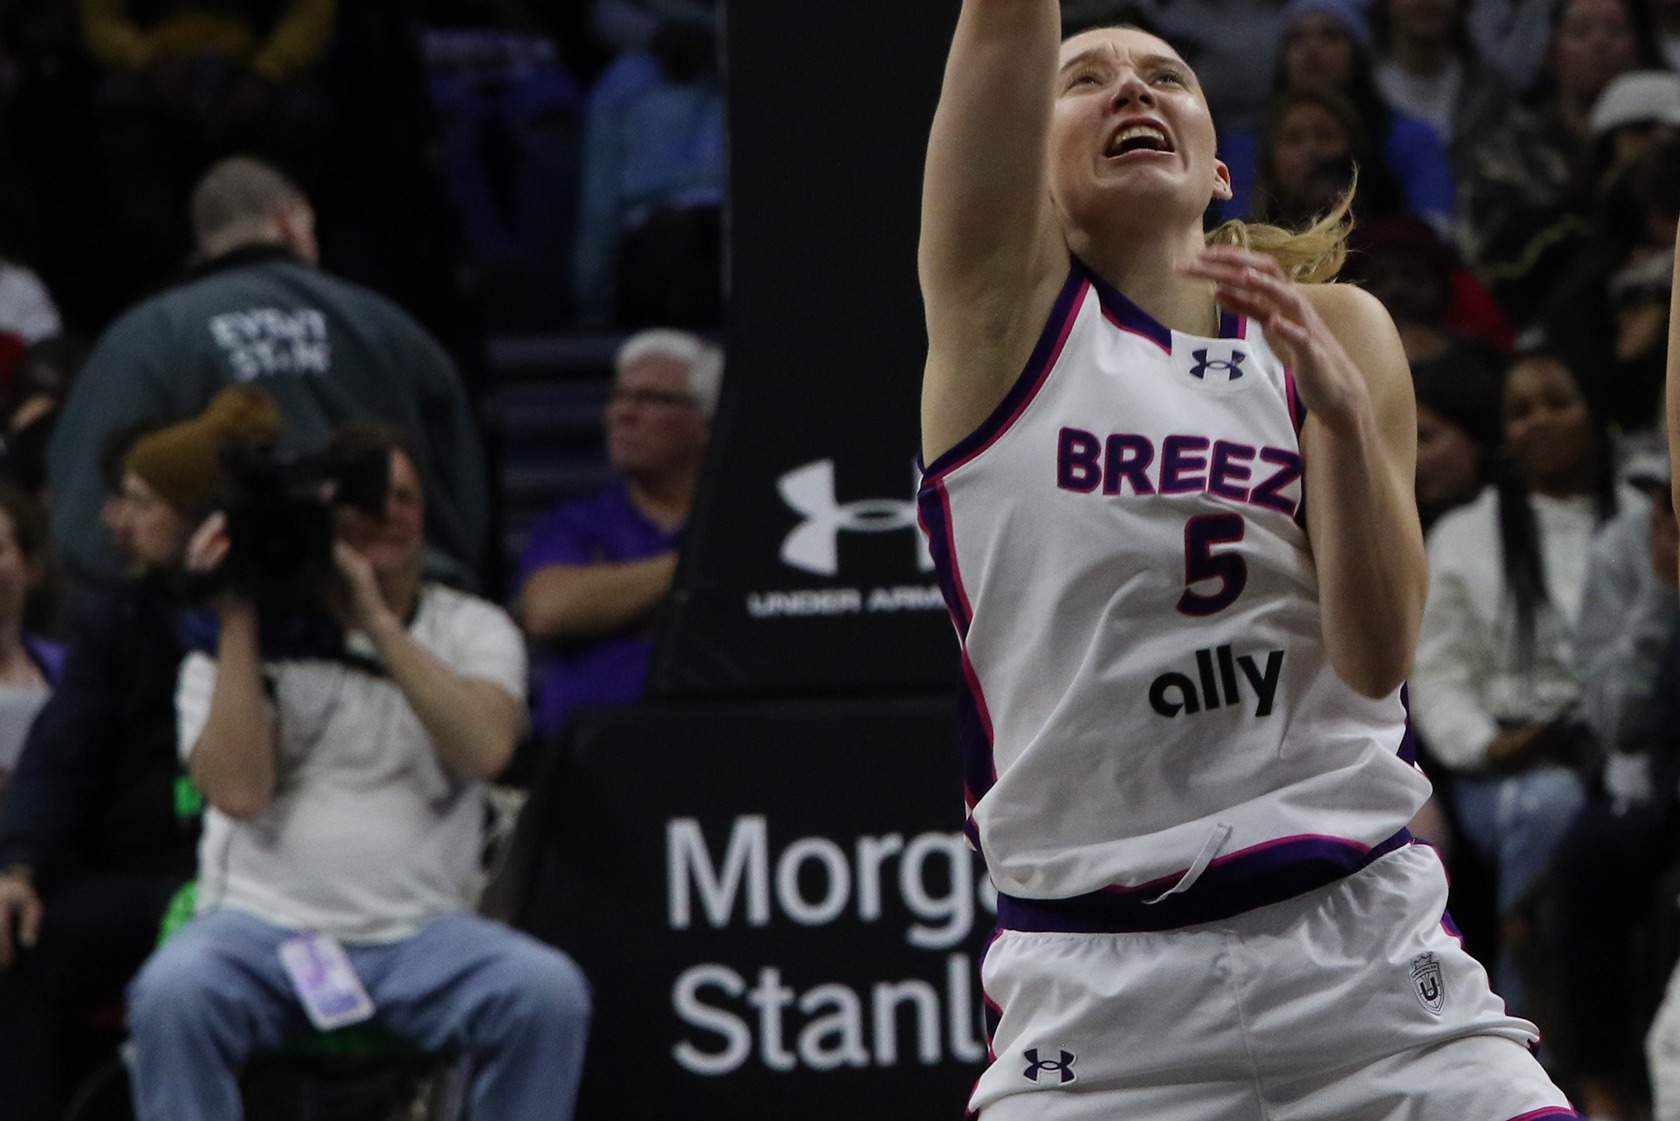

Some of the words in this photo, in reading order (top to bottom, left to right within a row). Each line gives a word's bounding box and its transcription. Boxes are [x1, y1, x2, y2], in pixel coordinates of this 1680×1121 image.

[1057, 426, 1302, 517] BREEZ
[746, 588, 863, 618] UNDER
[1175, 513, 1247, 616] 5
[1149, 644, 1284, 717] ally
[668, 950, 988, 1077] Stanl
